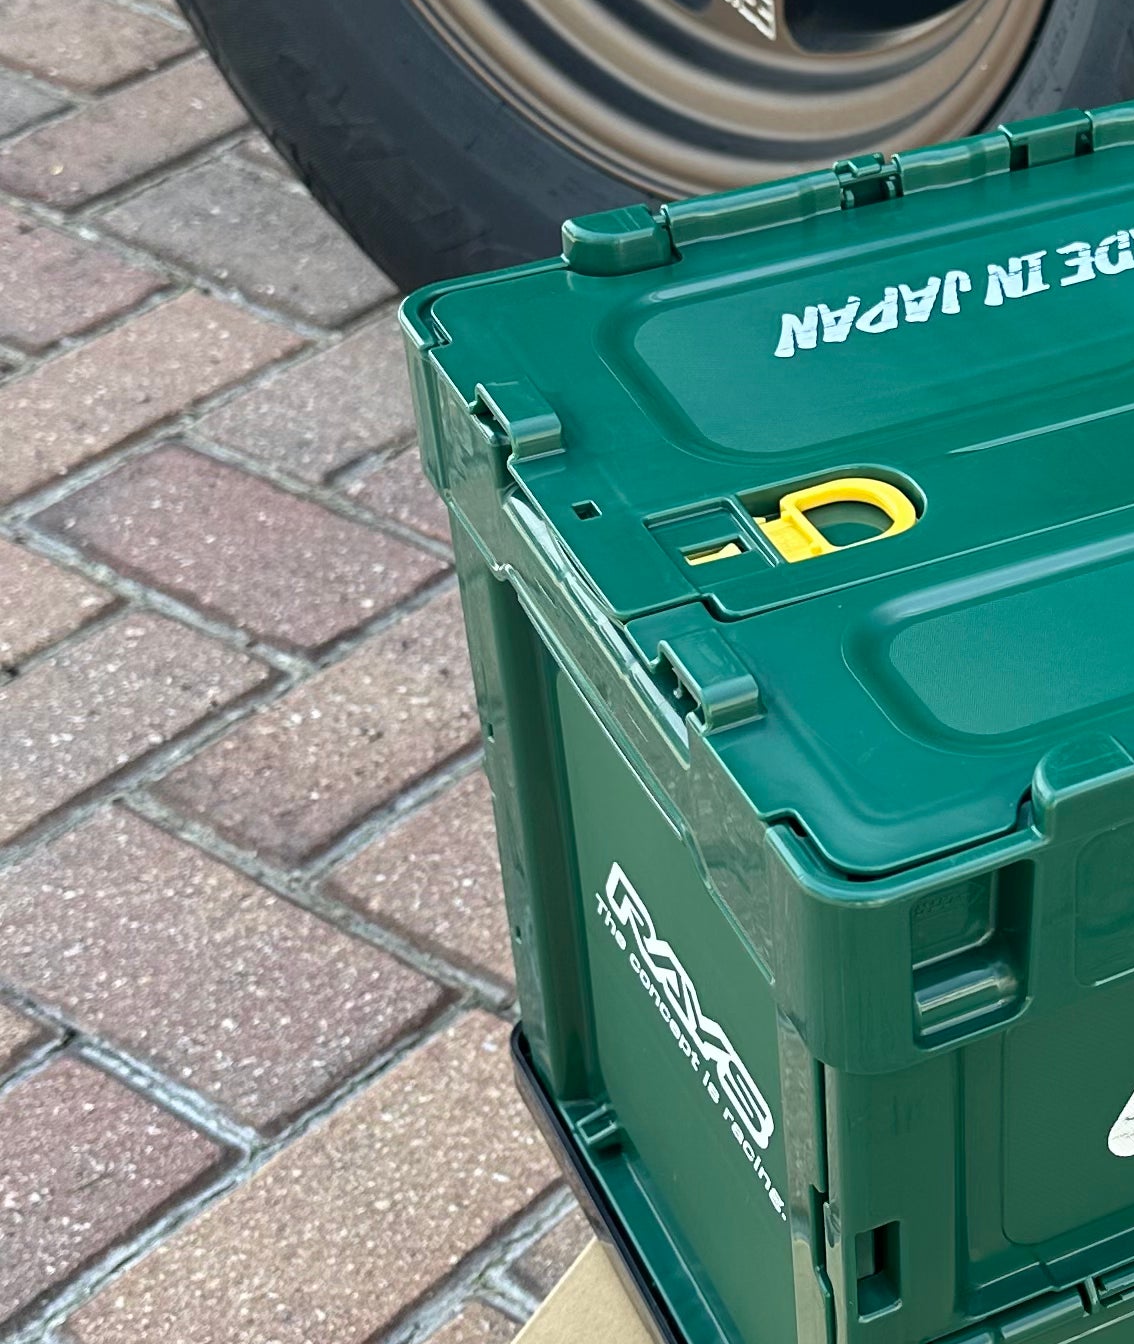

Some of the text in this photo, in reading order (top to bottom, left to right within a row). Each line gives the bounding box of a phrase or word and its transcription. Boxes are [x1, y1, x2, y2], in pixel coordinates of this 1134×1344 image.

[774, 270, 972, 358] JAPAN
[984, 250, 1051, 306] IN
[595, 892, 787, 1222] The concept is racing.
[605, 861, 775, 1150] RAYS
